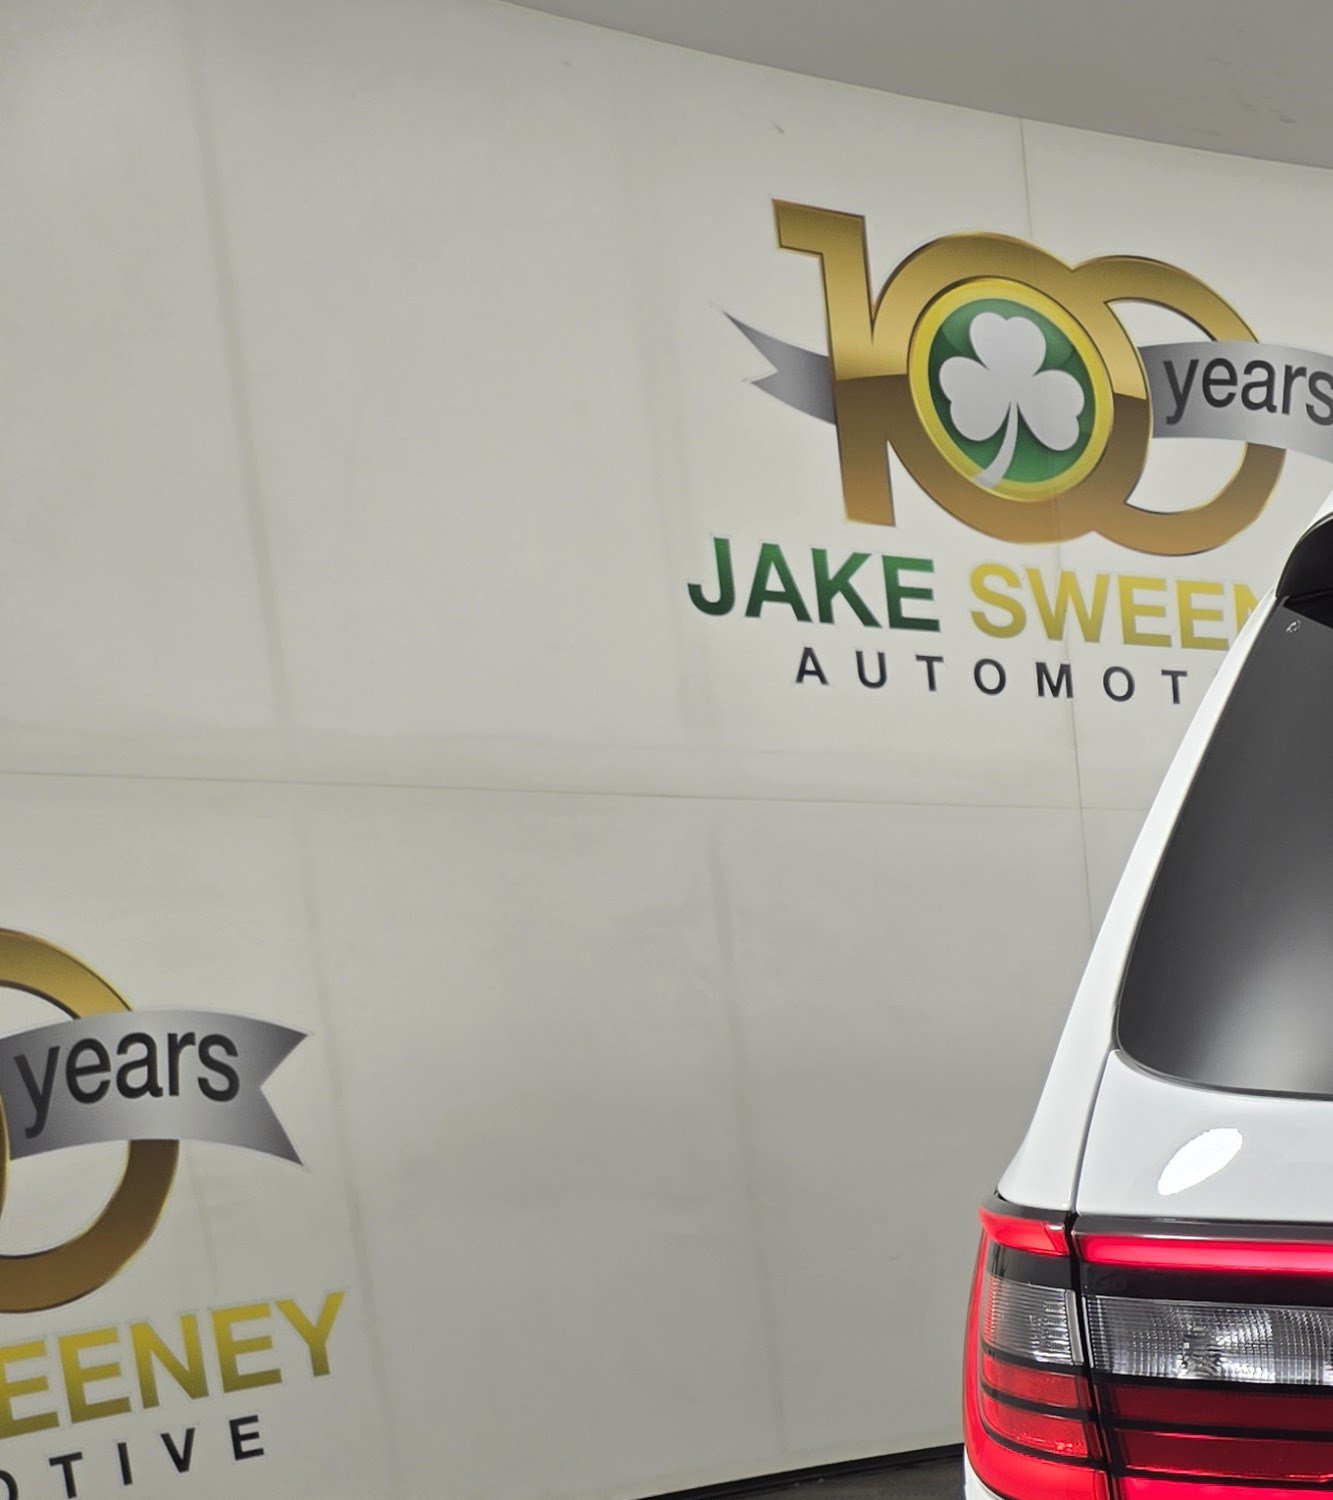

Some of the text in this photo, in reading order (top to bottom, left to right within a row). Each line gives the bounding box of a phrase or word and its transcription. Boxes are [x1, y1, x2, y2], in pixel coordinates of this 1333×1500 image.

[771, 198, 1287, 556] 100
[687, 537, 941, 632] JAKE
[14, 1031, 240, 1139] years
